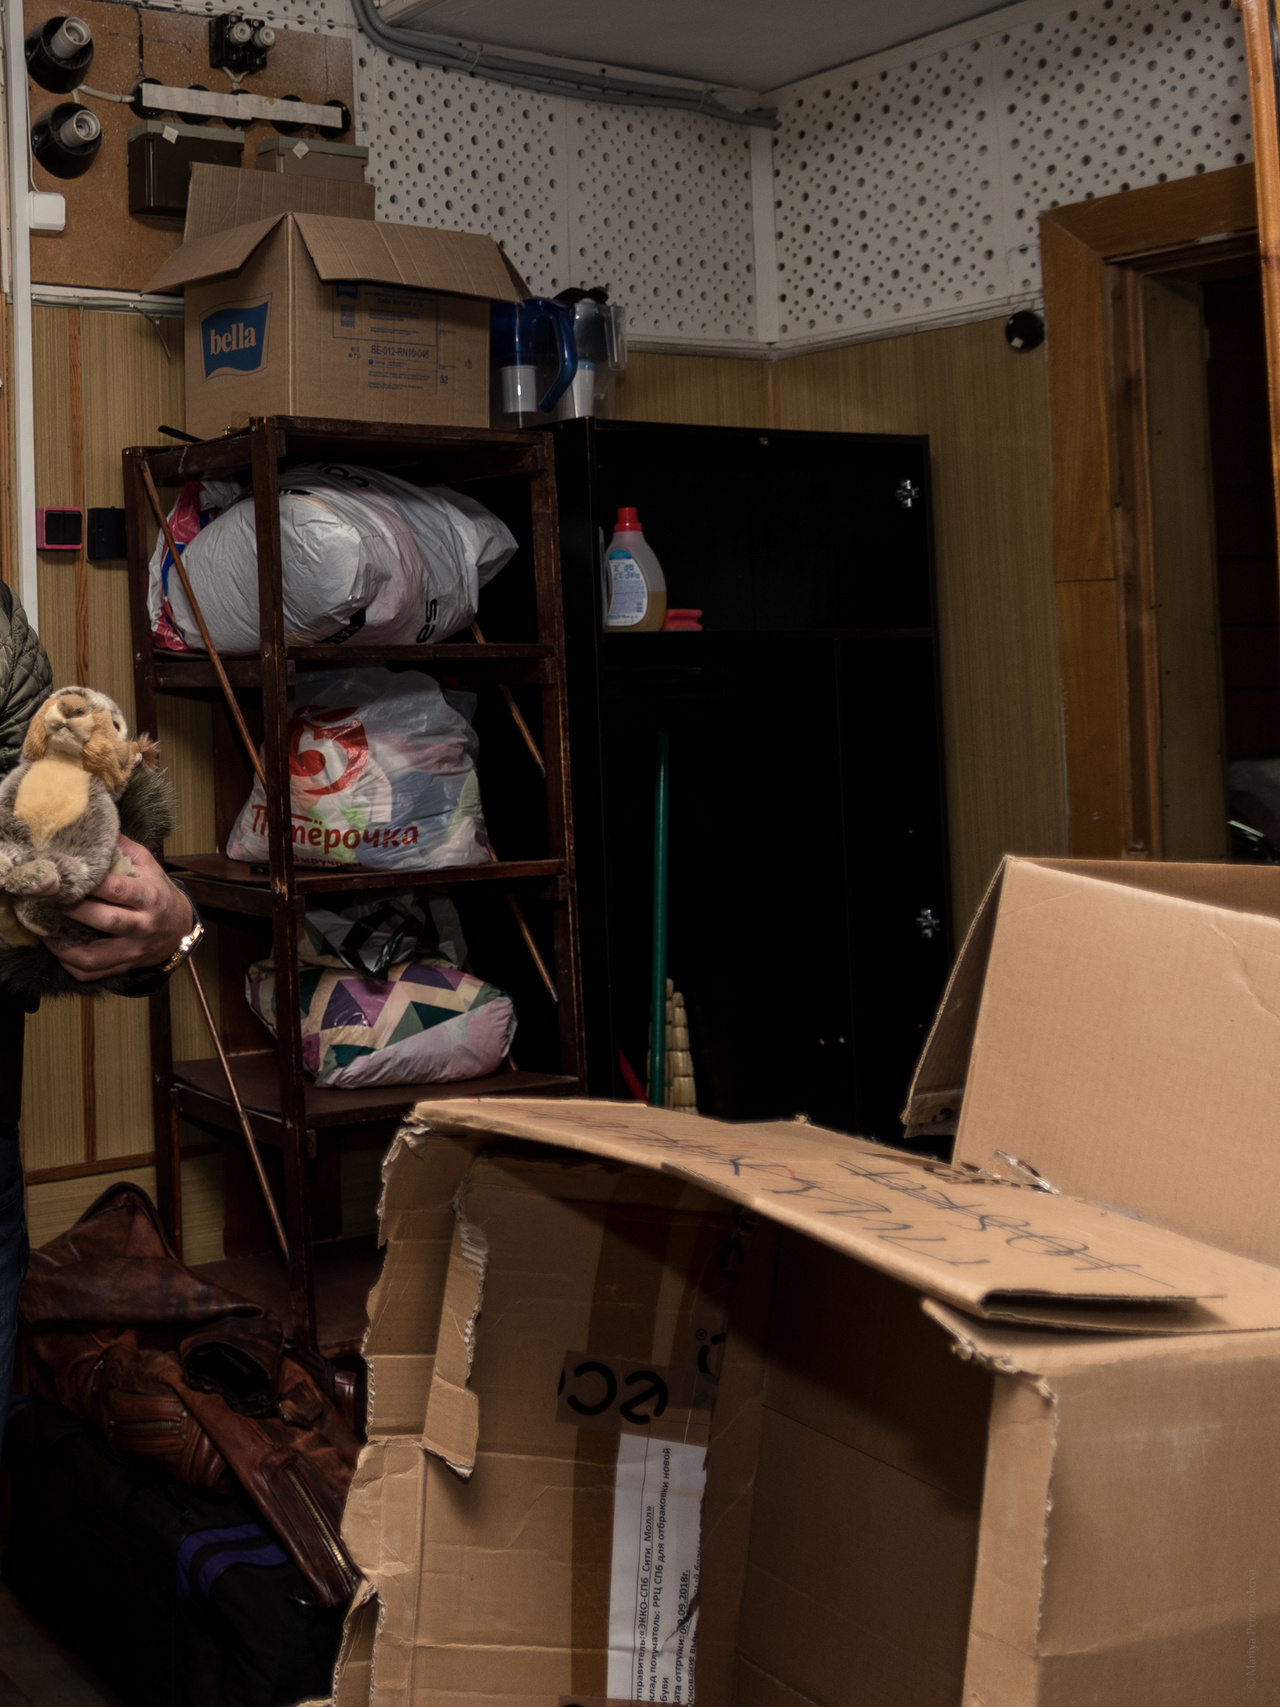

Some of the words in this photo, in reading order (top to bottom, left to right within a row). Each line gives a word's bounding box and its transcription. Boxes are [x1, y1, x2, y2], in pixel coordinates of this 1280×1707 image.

[210, 321, 257, 355] bella
[251, 804, 419, 854] Птёрочка
[557, 1361, 669, 1425] ec
[662, 1448, 671, 1479] новой
[657, 1481, 670, 1541] отбраковки
[642, 1547, 652, 1573] Сити
[656, 1542, 666, 1564] для
[653, 1564, 664, 1585] СПб
[652, 1586, 663, 1609] РРЦ
[648, 1675, 658, 1702] клад
[659, 1676, 670, 1703] буви
